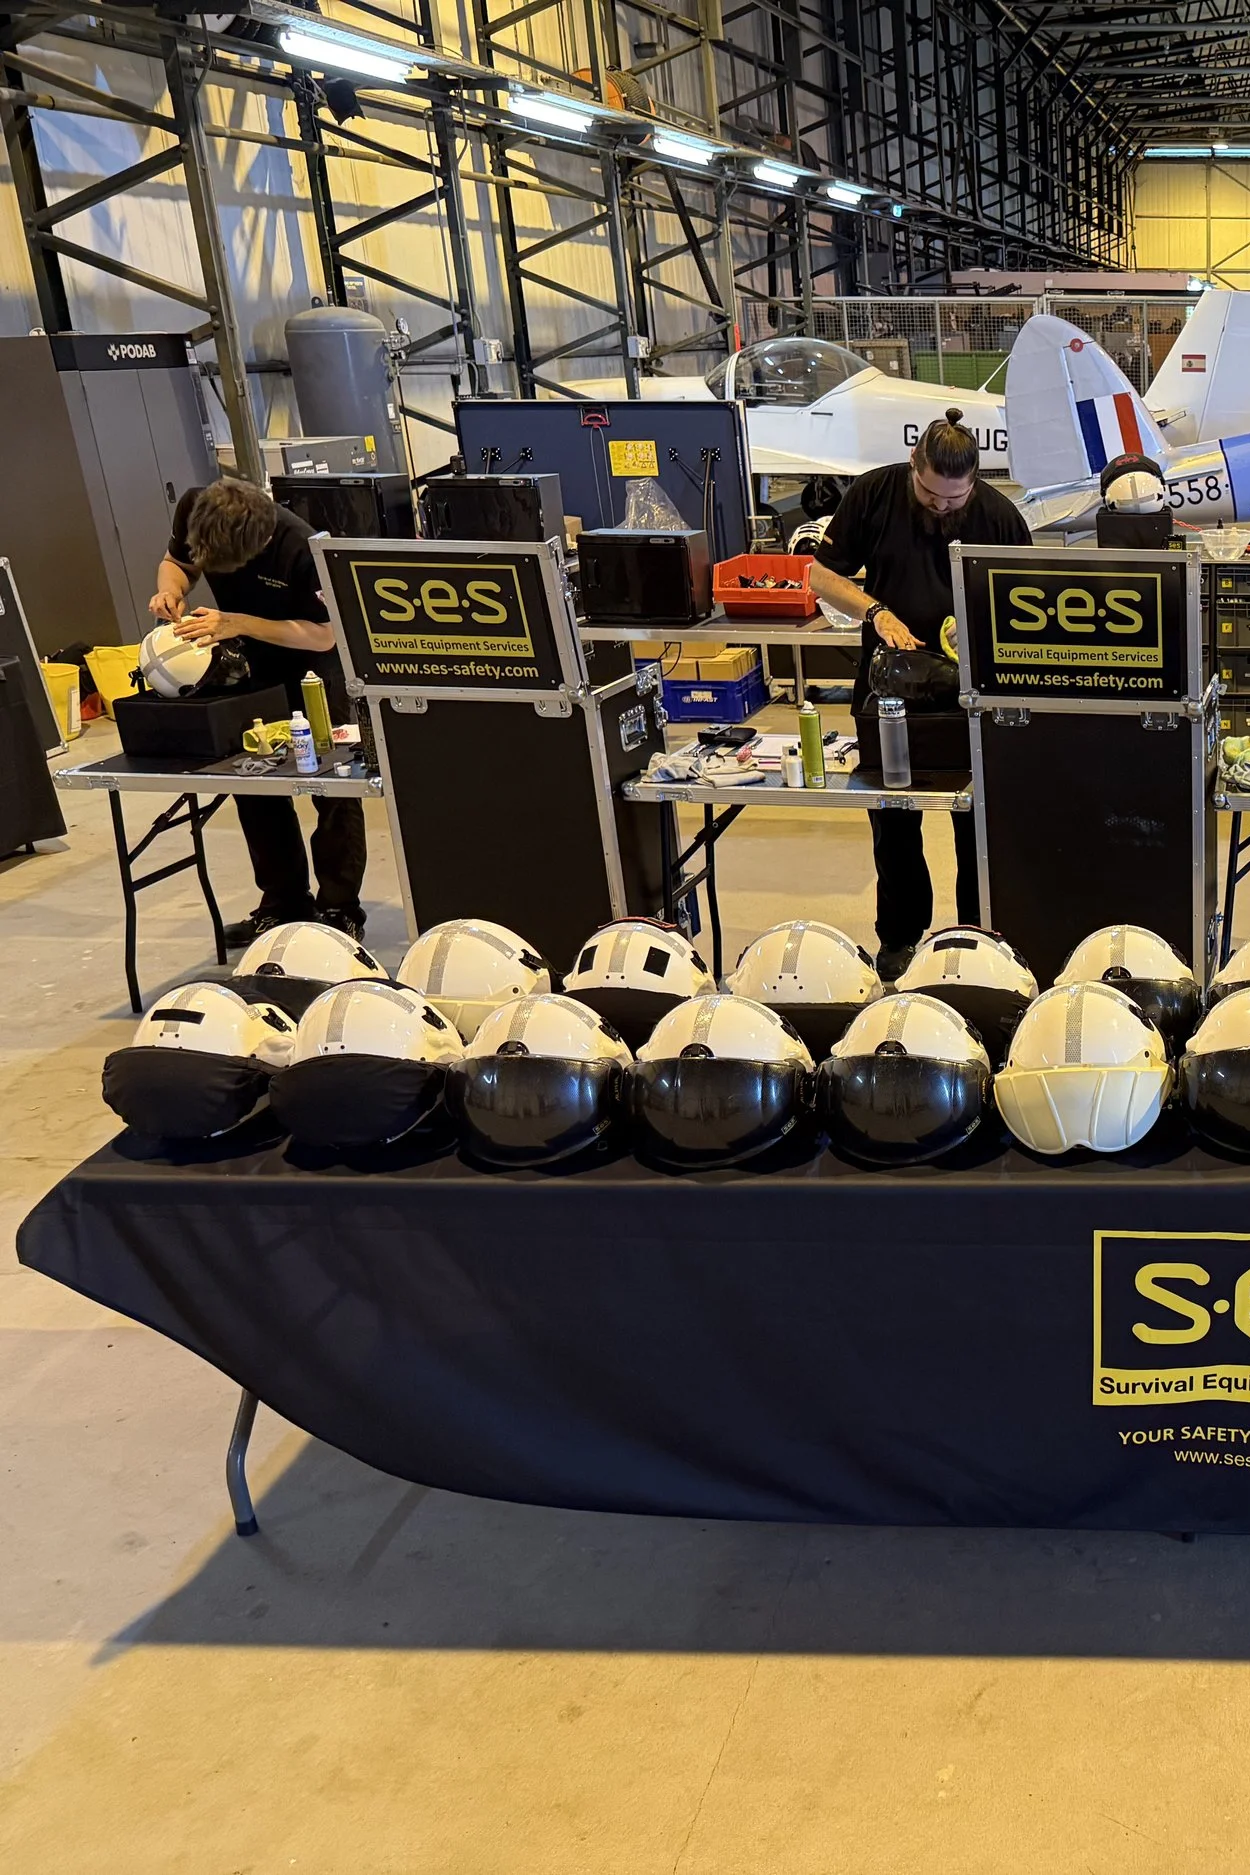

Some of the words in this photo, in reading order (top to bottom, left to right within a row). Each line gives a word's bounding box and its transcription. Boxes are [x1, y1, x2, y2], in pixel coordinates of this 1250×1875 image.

[119, 343, 157, 359] PODAB
[373, 638, 418, 649] Survival
[421, 639, 481, 652] Equipment
[483, 641, 530, 652] Services
[997, 648, 1043, 659] Survival
[1046, 649, 1109, 662] Equipment
[1111, 651, 1159, 662] Services
[375, 661, 539, 680] www.ses-safety.com
[995, 672, 1163, 690] www.ses-safety.com
[1099, 1375, 1194, 1395] Survival
[1118, 1427, 1175, 1446] YOUR
